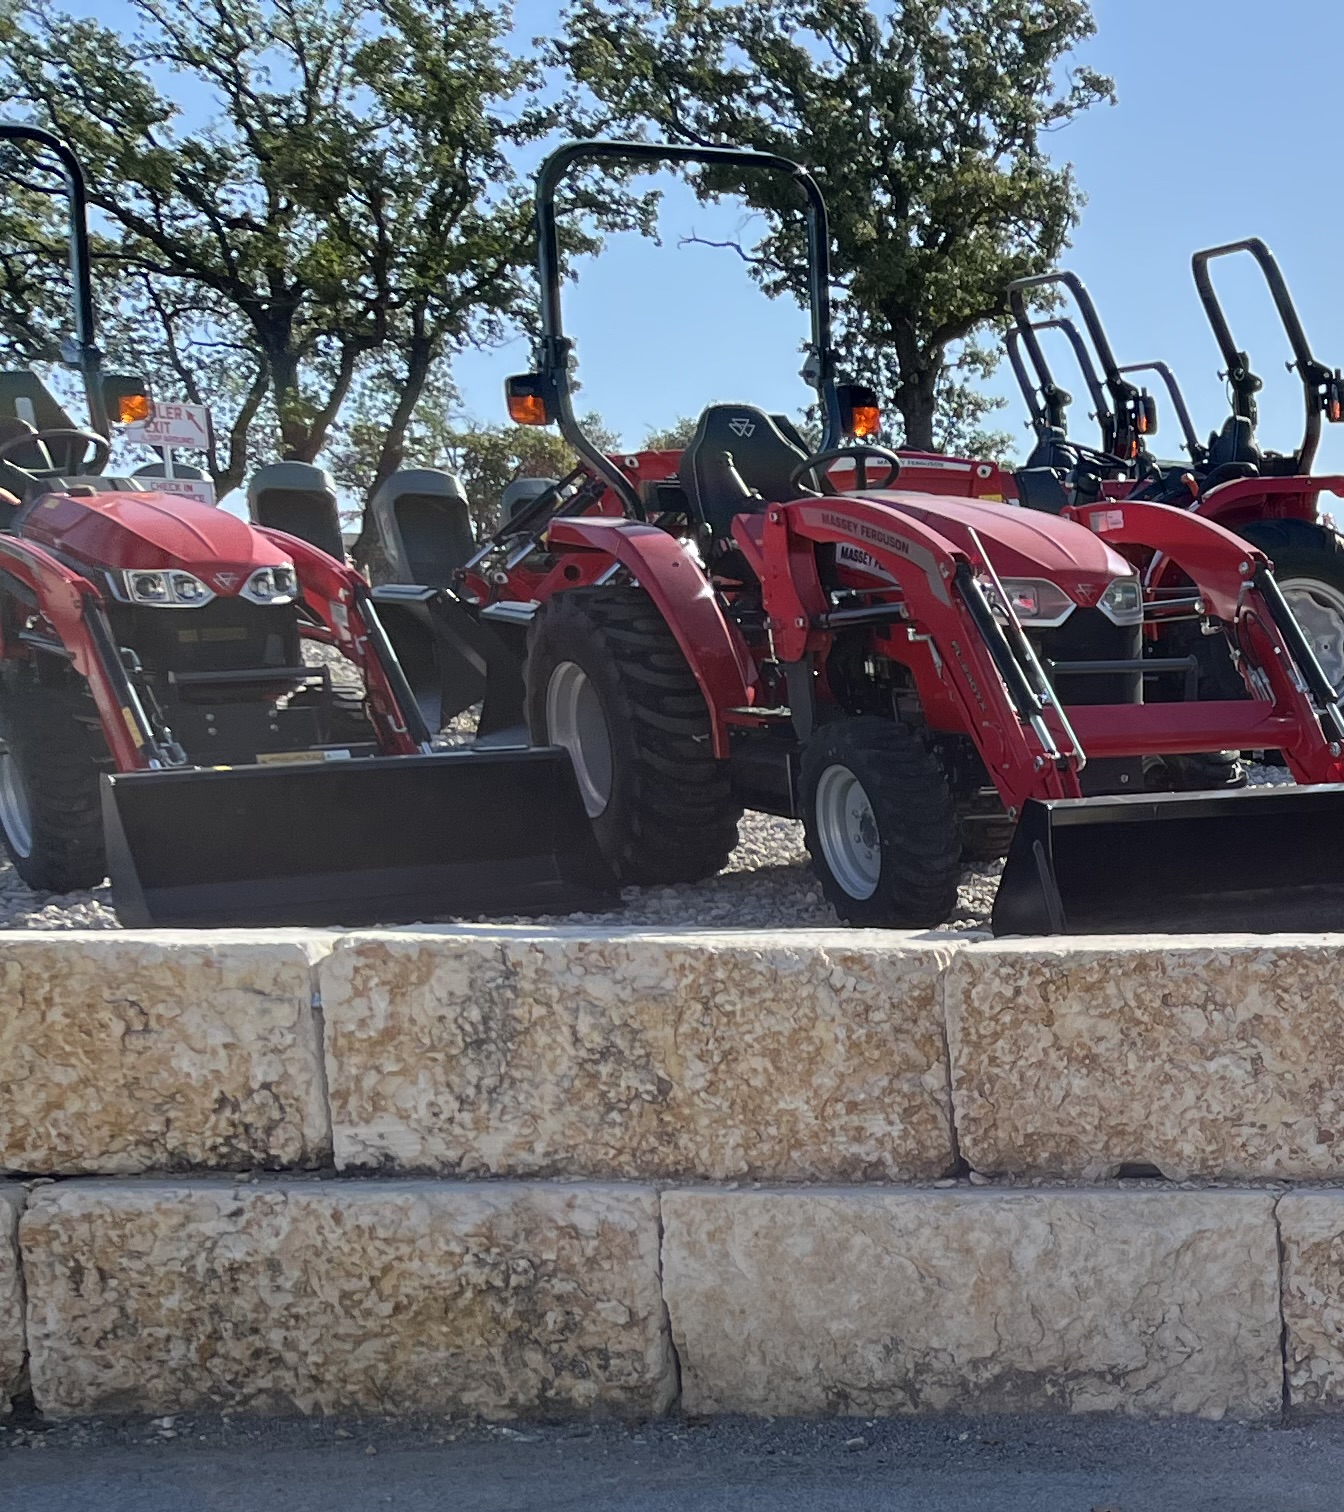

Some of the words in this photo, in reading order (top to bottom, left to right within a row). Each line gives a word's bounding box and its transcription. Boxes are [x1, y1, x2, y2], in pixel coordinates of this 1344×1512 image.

[821, 512, 859, 536] MASSEY
[861, 523, 910, 555] FERGUSON
[840, 545, 873, 567] MASSEY
